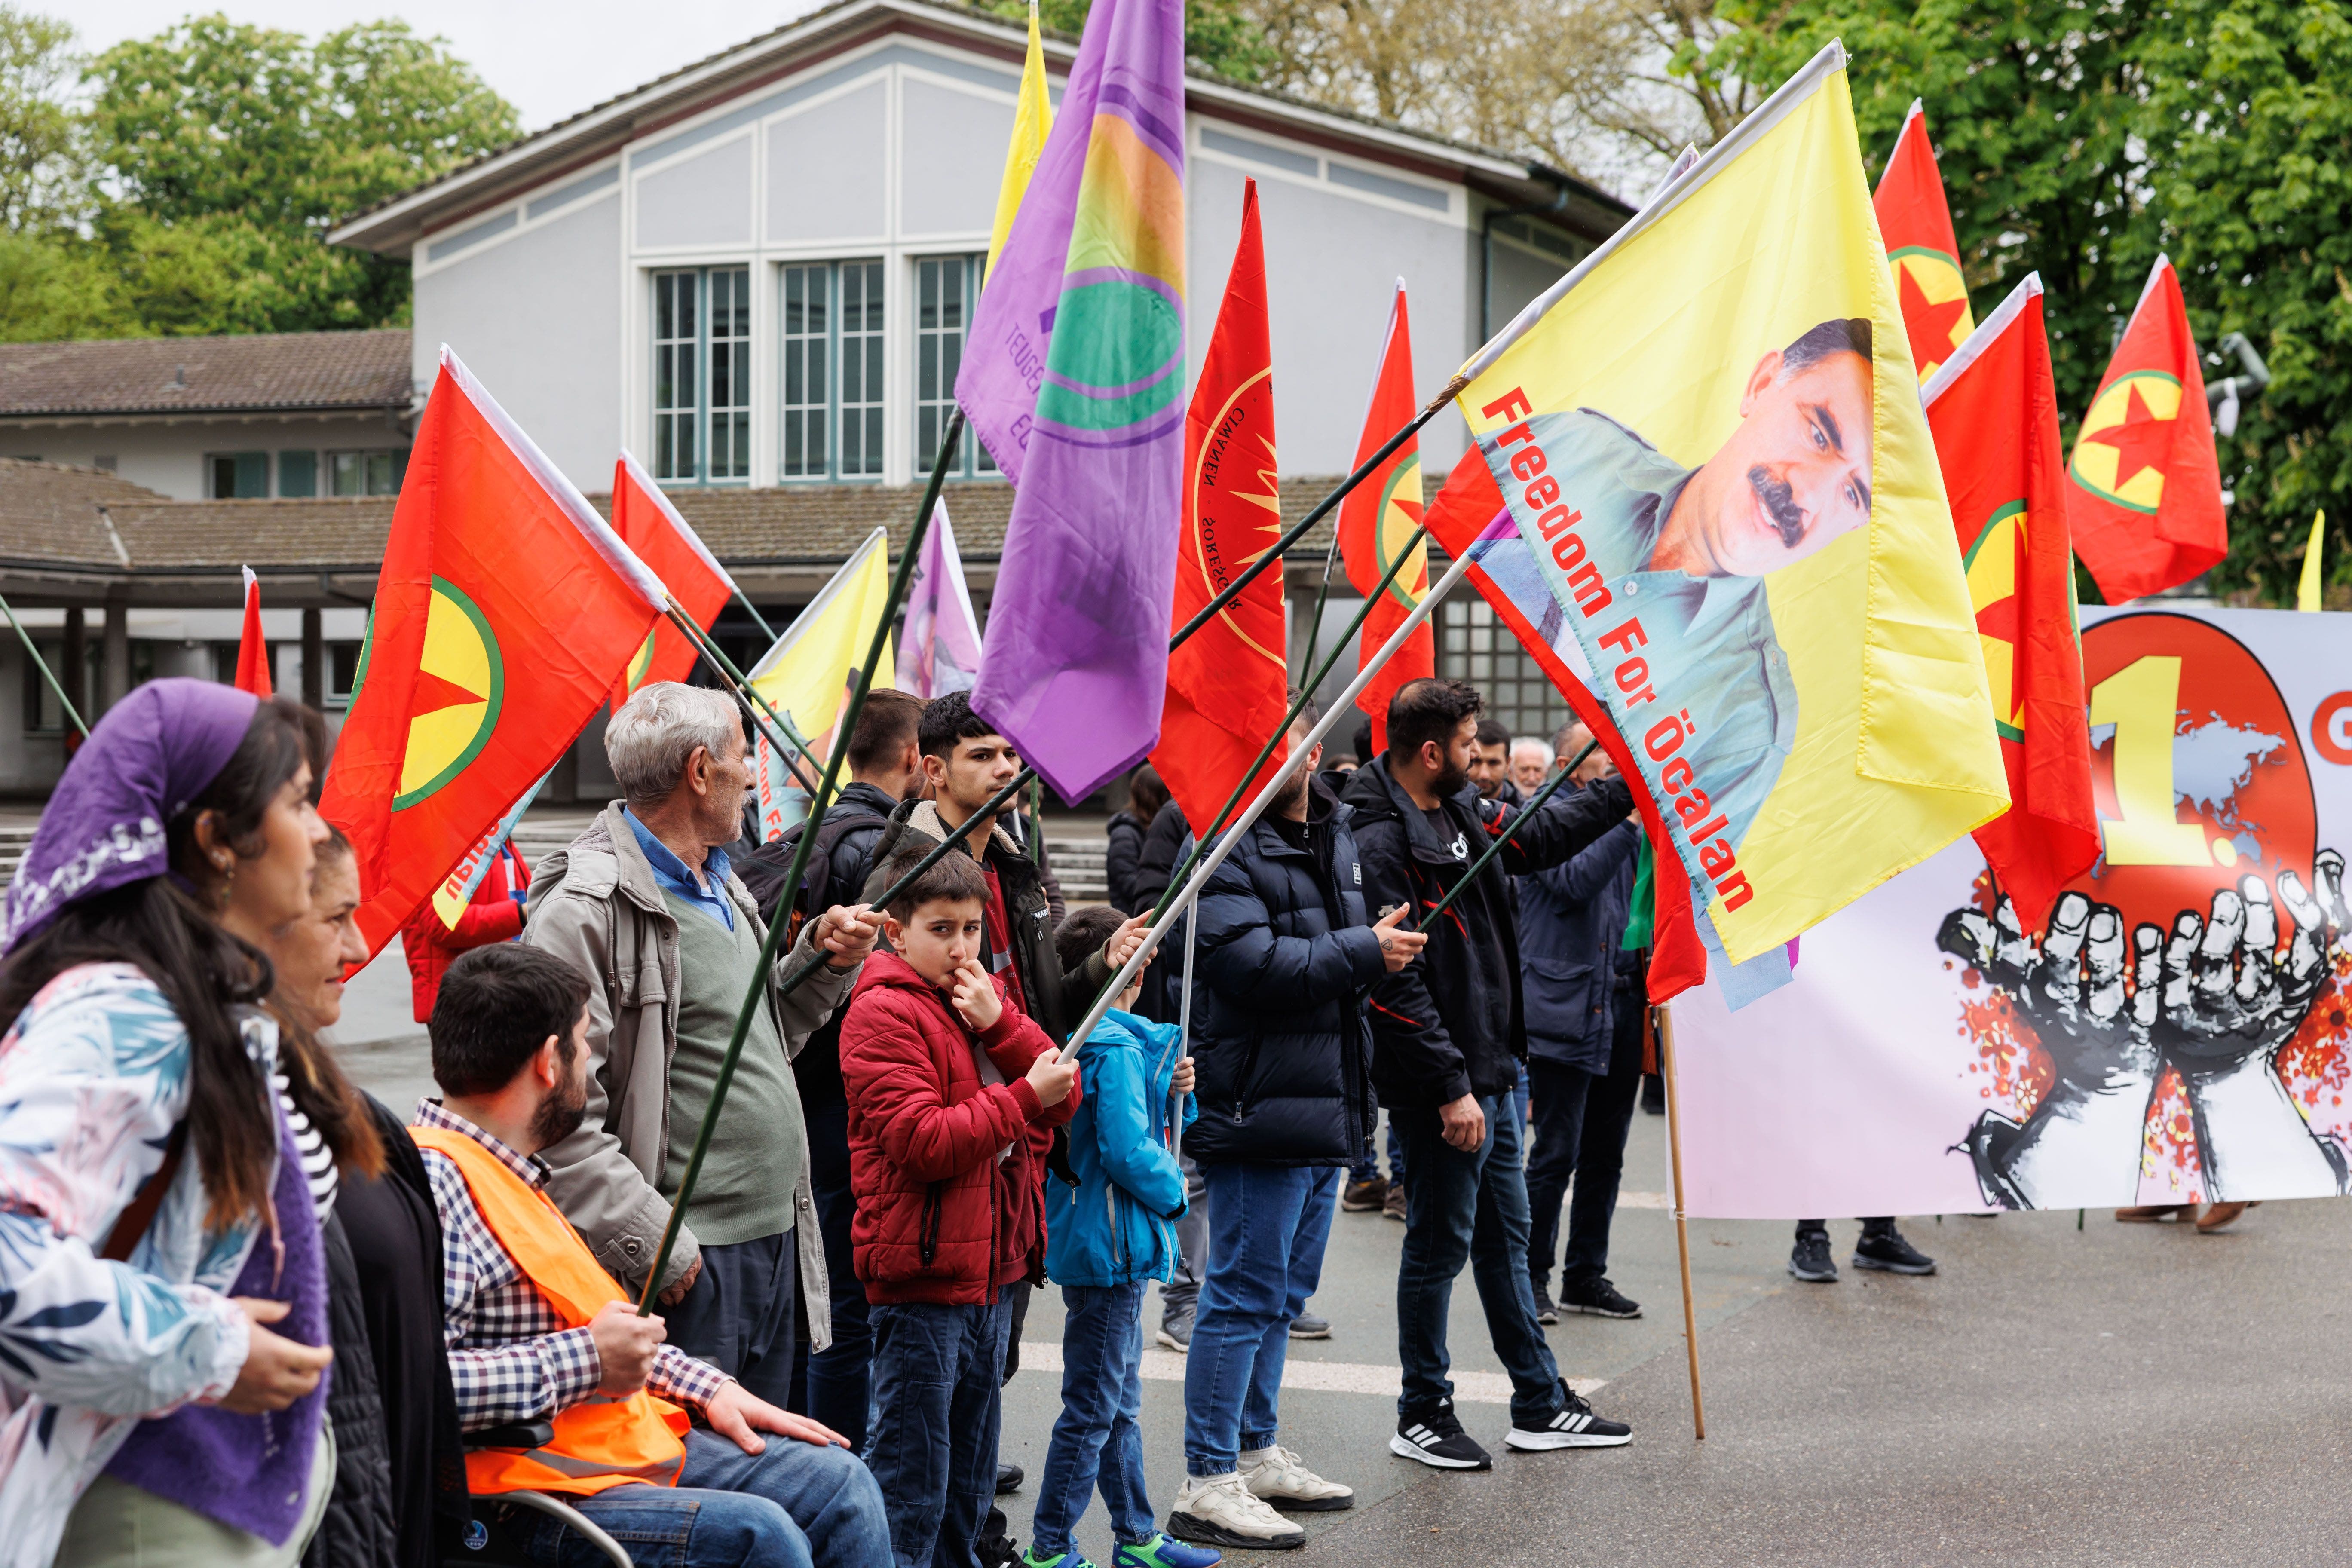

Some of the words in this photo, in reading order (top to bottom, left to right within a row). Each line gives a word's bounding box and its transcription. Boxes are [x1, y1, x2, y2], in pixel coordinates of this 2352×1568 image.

[1481, 386, 1613, 619] Freedom
[1597, 616, 1657, 709] For
[1644, 707, 1754, 914] Öcalan
